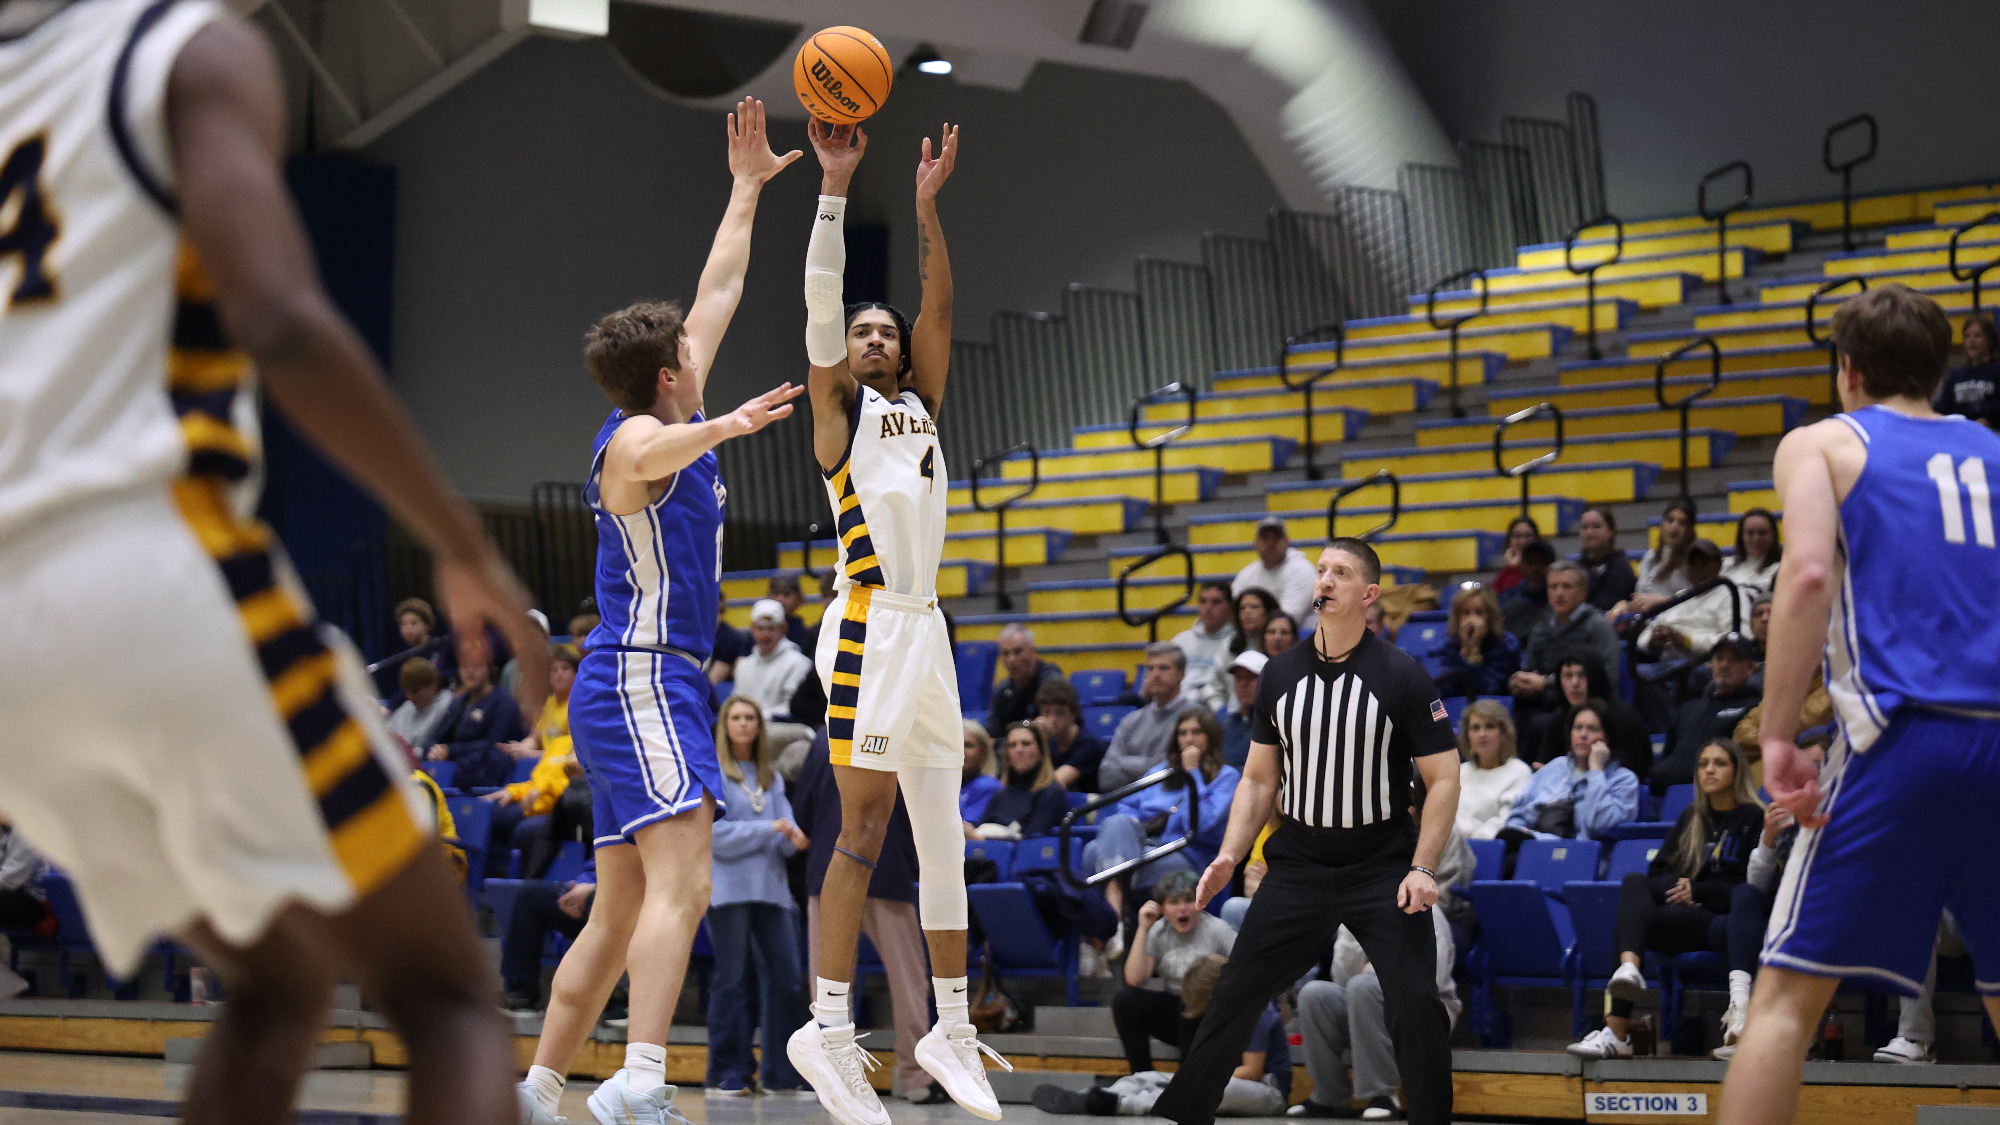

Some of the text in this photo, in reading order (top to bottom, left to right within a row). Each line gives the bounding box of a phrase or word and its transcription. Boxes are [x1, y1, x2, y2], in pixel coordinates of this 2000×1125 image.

[811, 58, 860, 113] Wilson
[0, 129, 60, 307] 4
[919, 444, 934, 494] 4
[1926, 452, 1997, 551] 11
[860, 734, 889, 755] AU
[1595, 1096, 1698, 1112] SECTION 3
